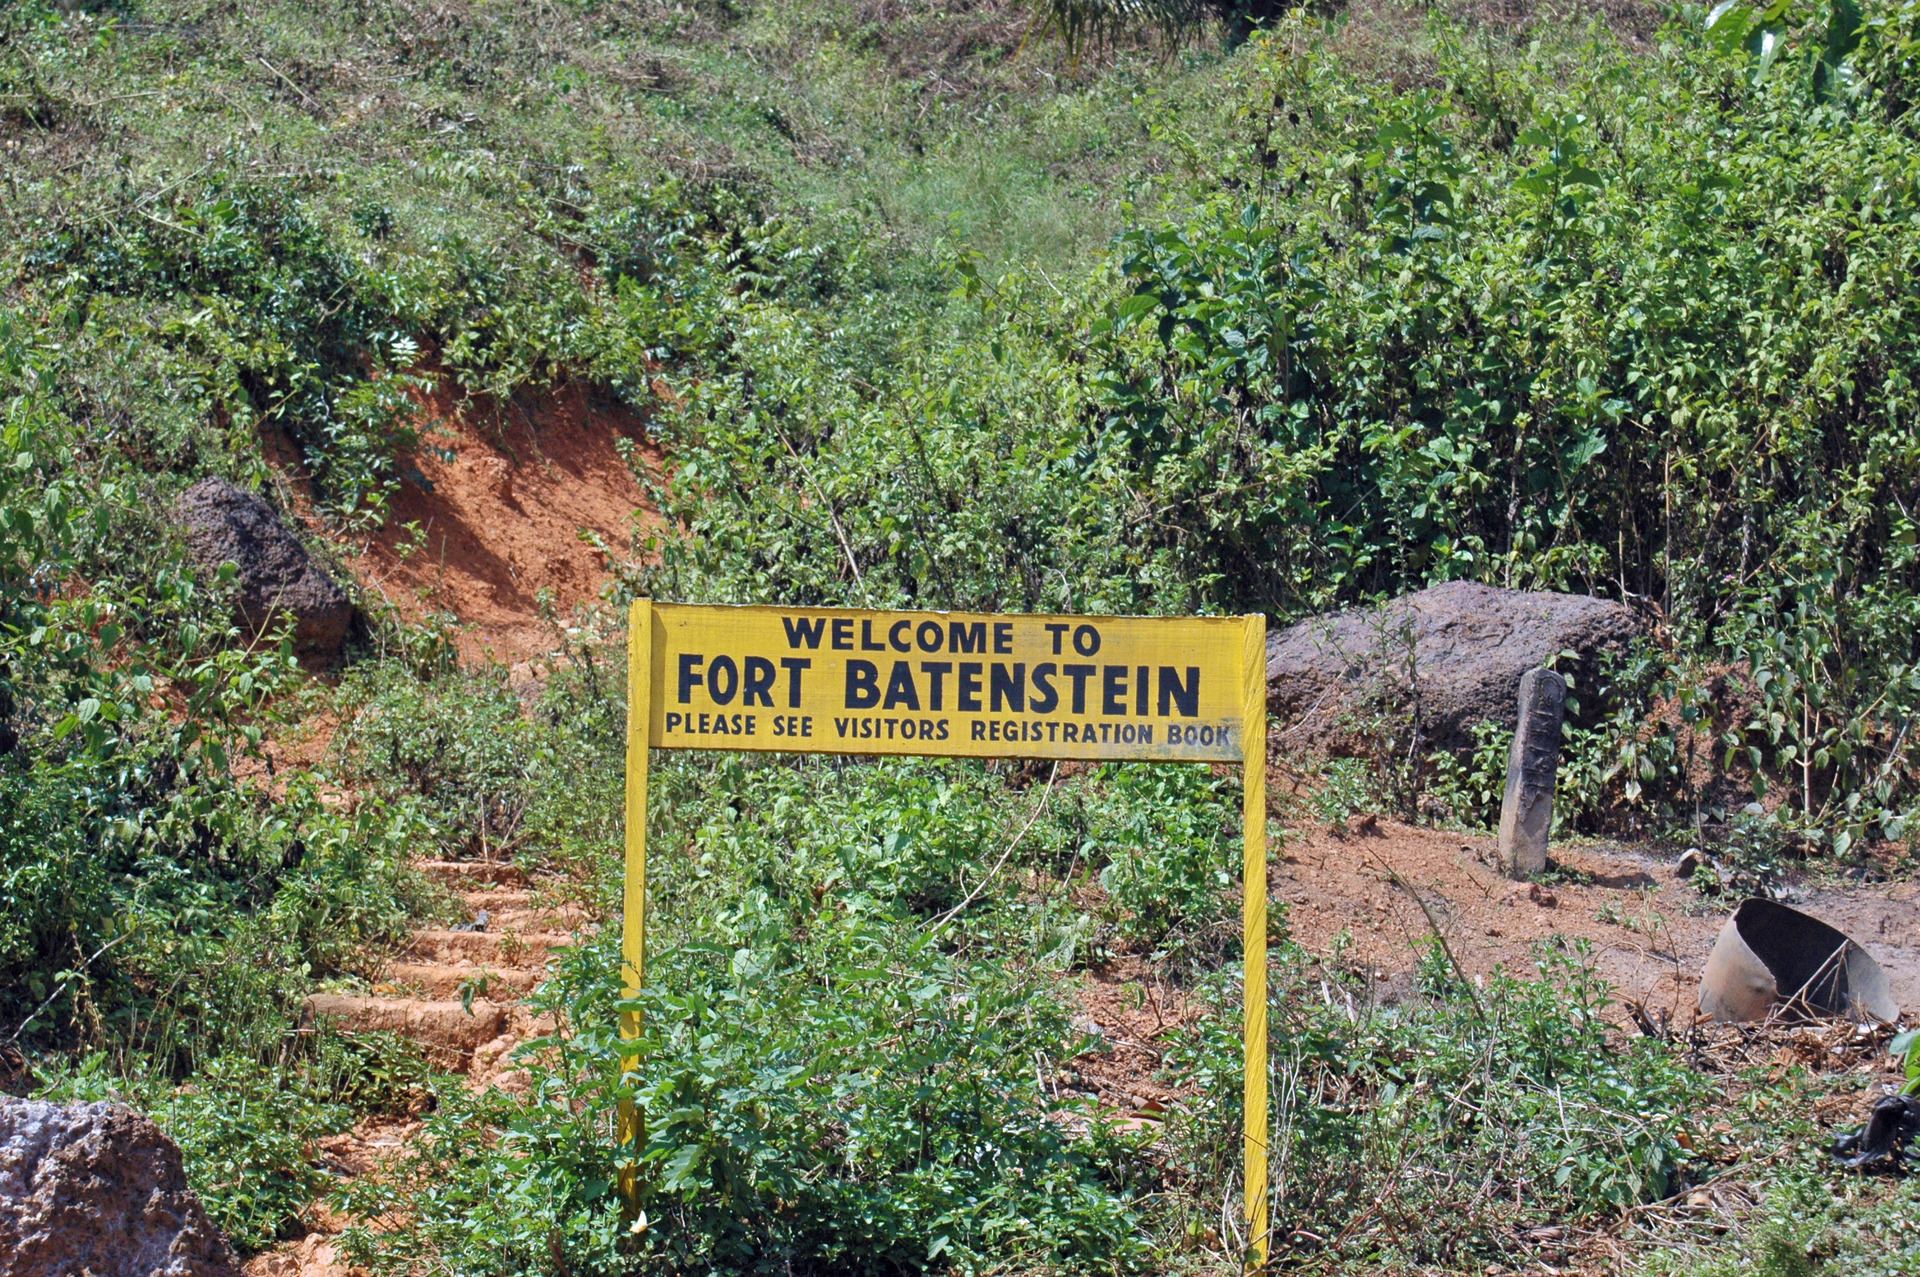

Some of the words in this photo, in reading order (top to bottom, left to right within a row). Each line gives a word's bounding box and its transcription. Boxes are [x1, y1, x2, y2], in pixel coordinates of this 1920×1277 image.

[783, 618, 1013, 654] WELCOME
[1046, 624, 1101, 656] TO
[678, 654, 811, 708] FORT
[845, 660, 1200, 717] BATENSTEIN
[666, 713, 756, 735] PLEASE
[774, 716, 813, 737] SEE
[835, 717, 949, 741] VISITORS
[972, 720, 1153, 744] REGISTRATION
[1167, 724, 1231, 747] BOOK
